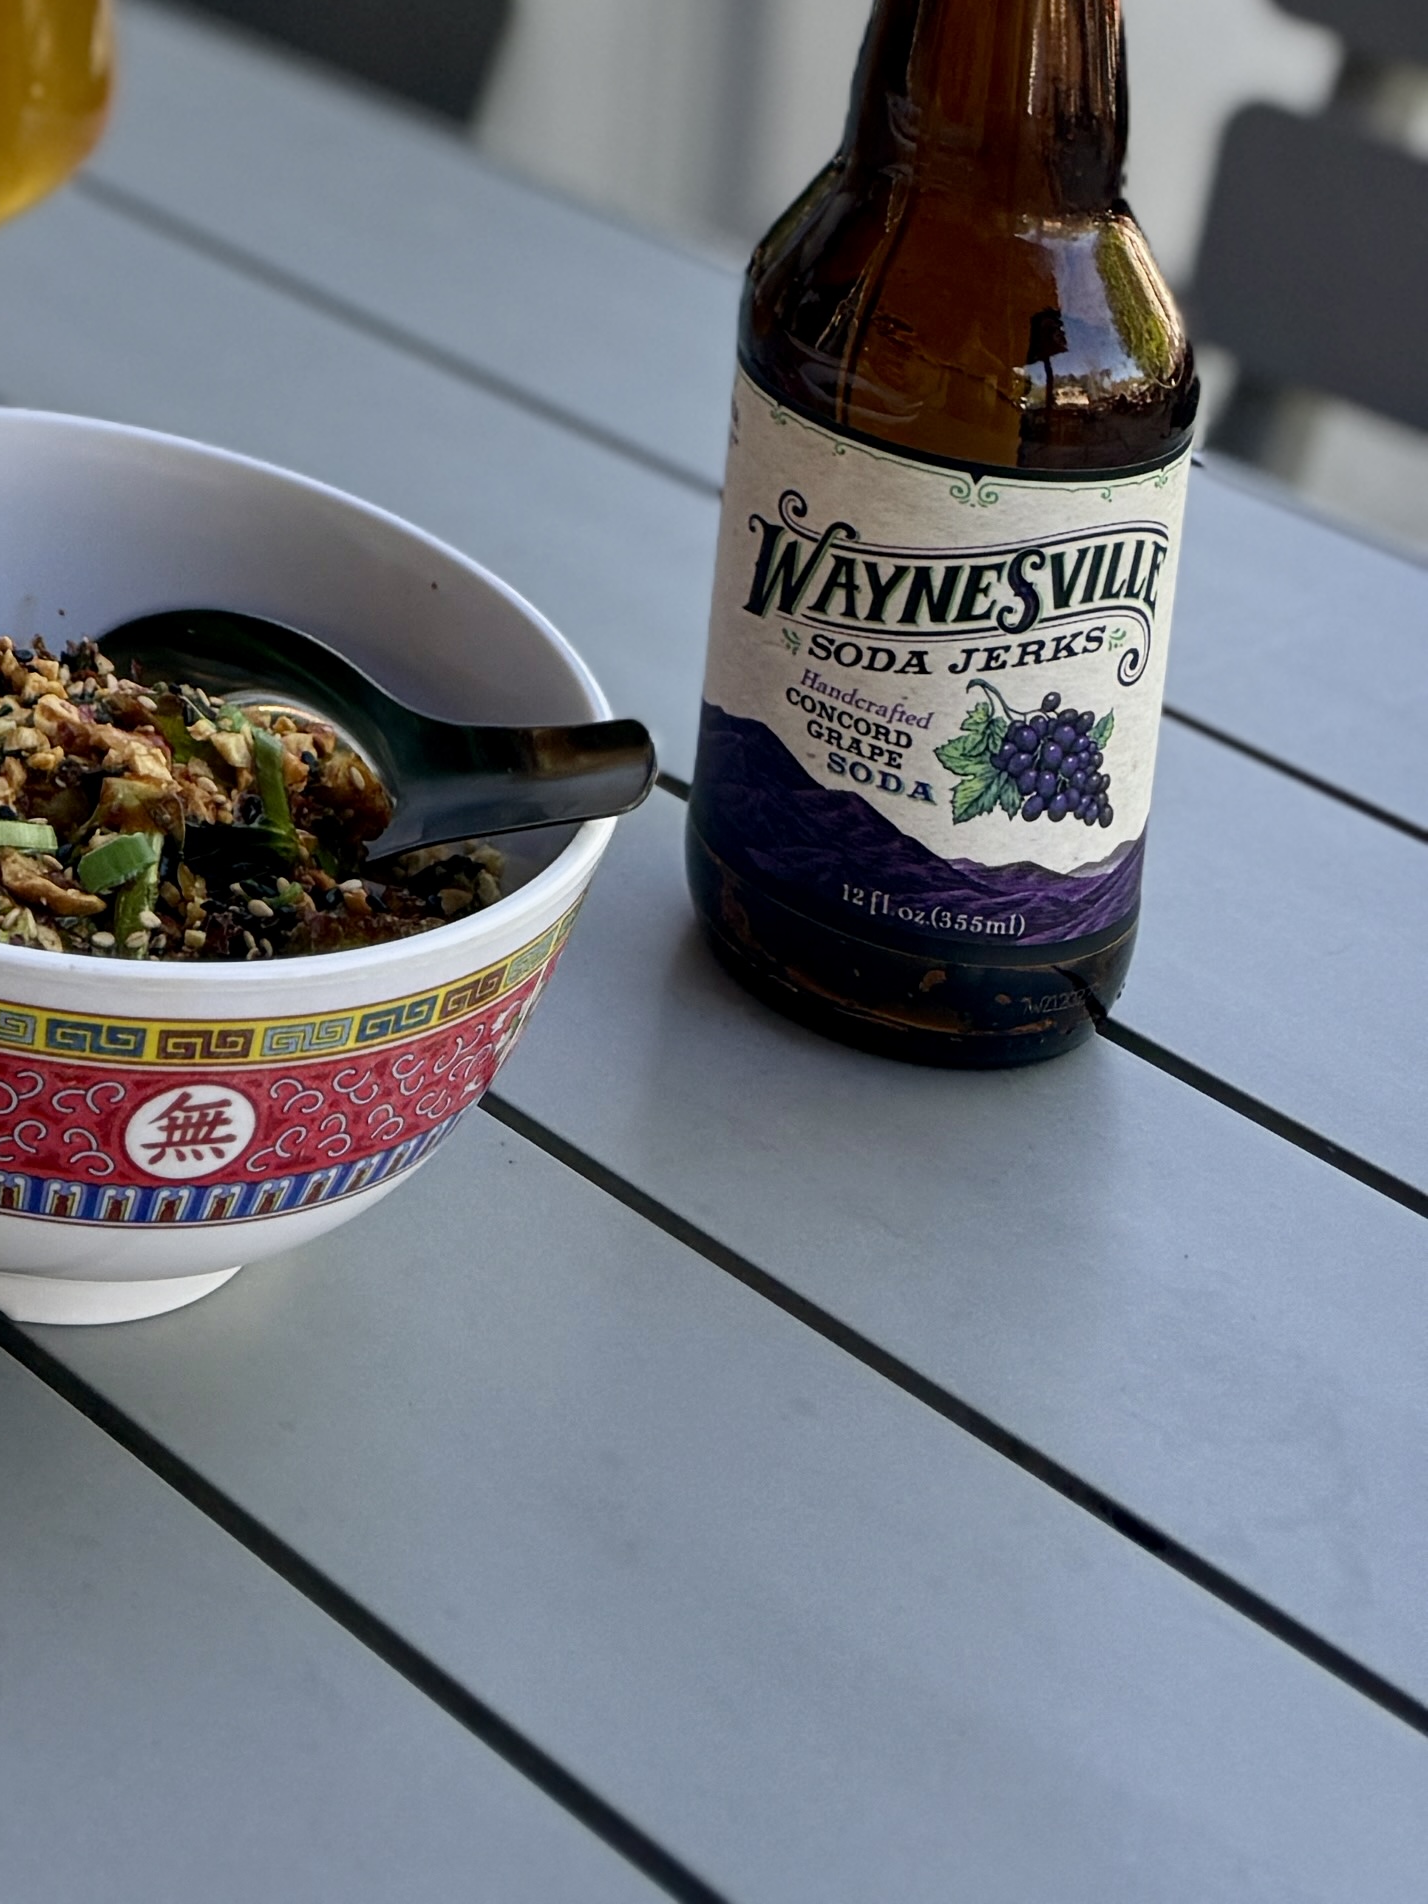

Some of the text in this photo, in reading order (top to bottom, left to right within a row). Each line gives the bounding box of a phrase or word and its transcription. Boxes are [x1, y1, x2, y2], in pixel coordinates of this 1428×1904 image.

[807, 623, 1107, 676] SODA JERKS
[785, 687, 913, 749] CONCORD
[800, 668, 935, 730] Handcrafted
[807, 719, 904, 769] GRAPE
[826, 751, 938, 806] SODA
[842, 882, 866, 907] 12
[140, 1091, 238, 1166] 無
